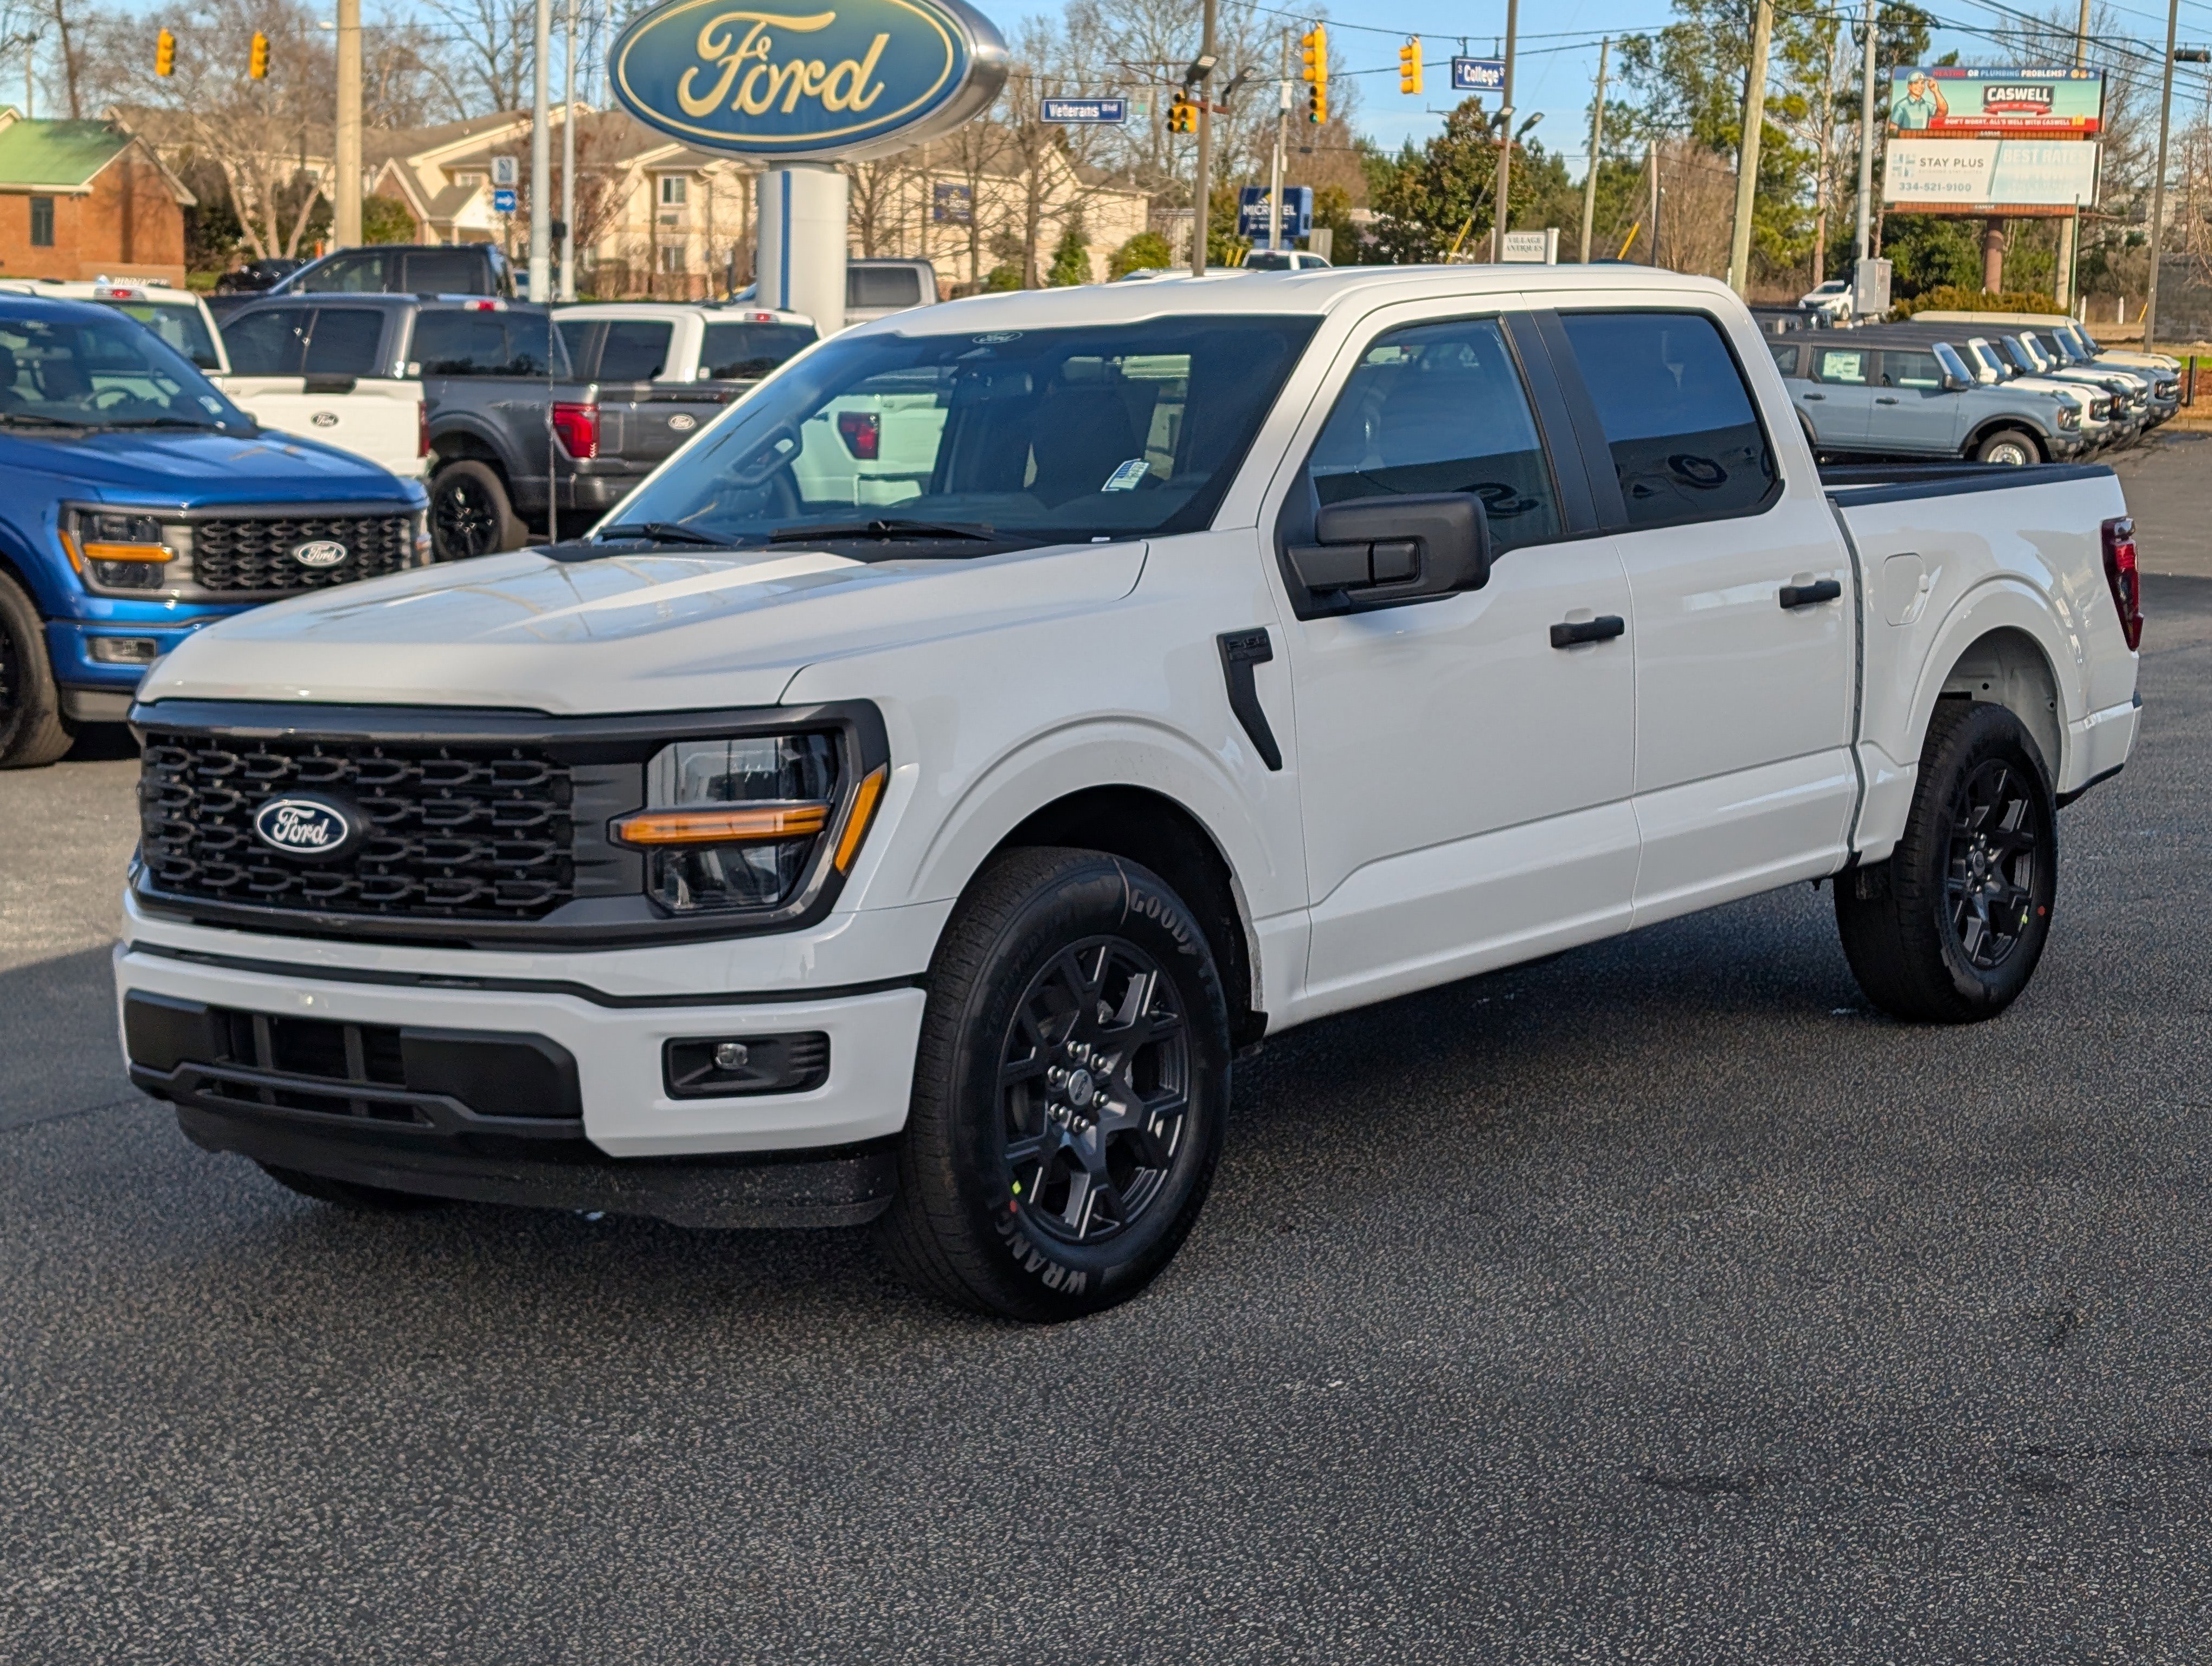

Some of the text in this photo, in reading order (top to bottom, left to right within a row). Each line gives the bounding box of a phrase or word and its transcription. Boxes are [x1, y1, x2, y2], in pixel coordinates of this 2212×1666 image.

[677, 11, 890, 117] Ford
[1464, 64, 1499, 86] College
[1967, 69, 1979, 77] OR
[1980, 69, 2020, 77] PLUMBING
[2021, 69, 2067, 78] PROBLEMS?
[1987, 87, 2050, 103] CASWELL
[1049, 104, 1100, 117] Veterans
[1920, 157, 1984, 168] STAY PLUS
[2003, 149, 2039, 163] BEST
[1899, 182, 1972, 192] 334-521-9100
[1508, 236, 1541, 244] VILLAGE
[1507, 245, 1543, 253] ANTIQUES
[307, 544, 337, 562] Ford
[273, 806, 330, 844] Ford
